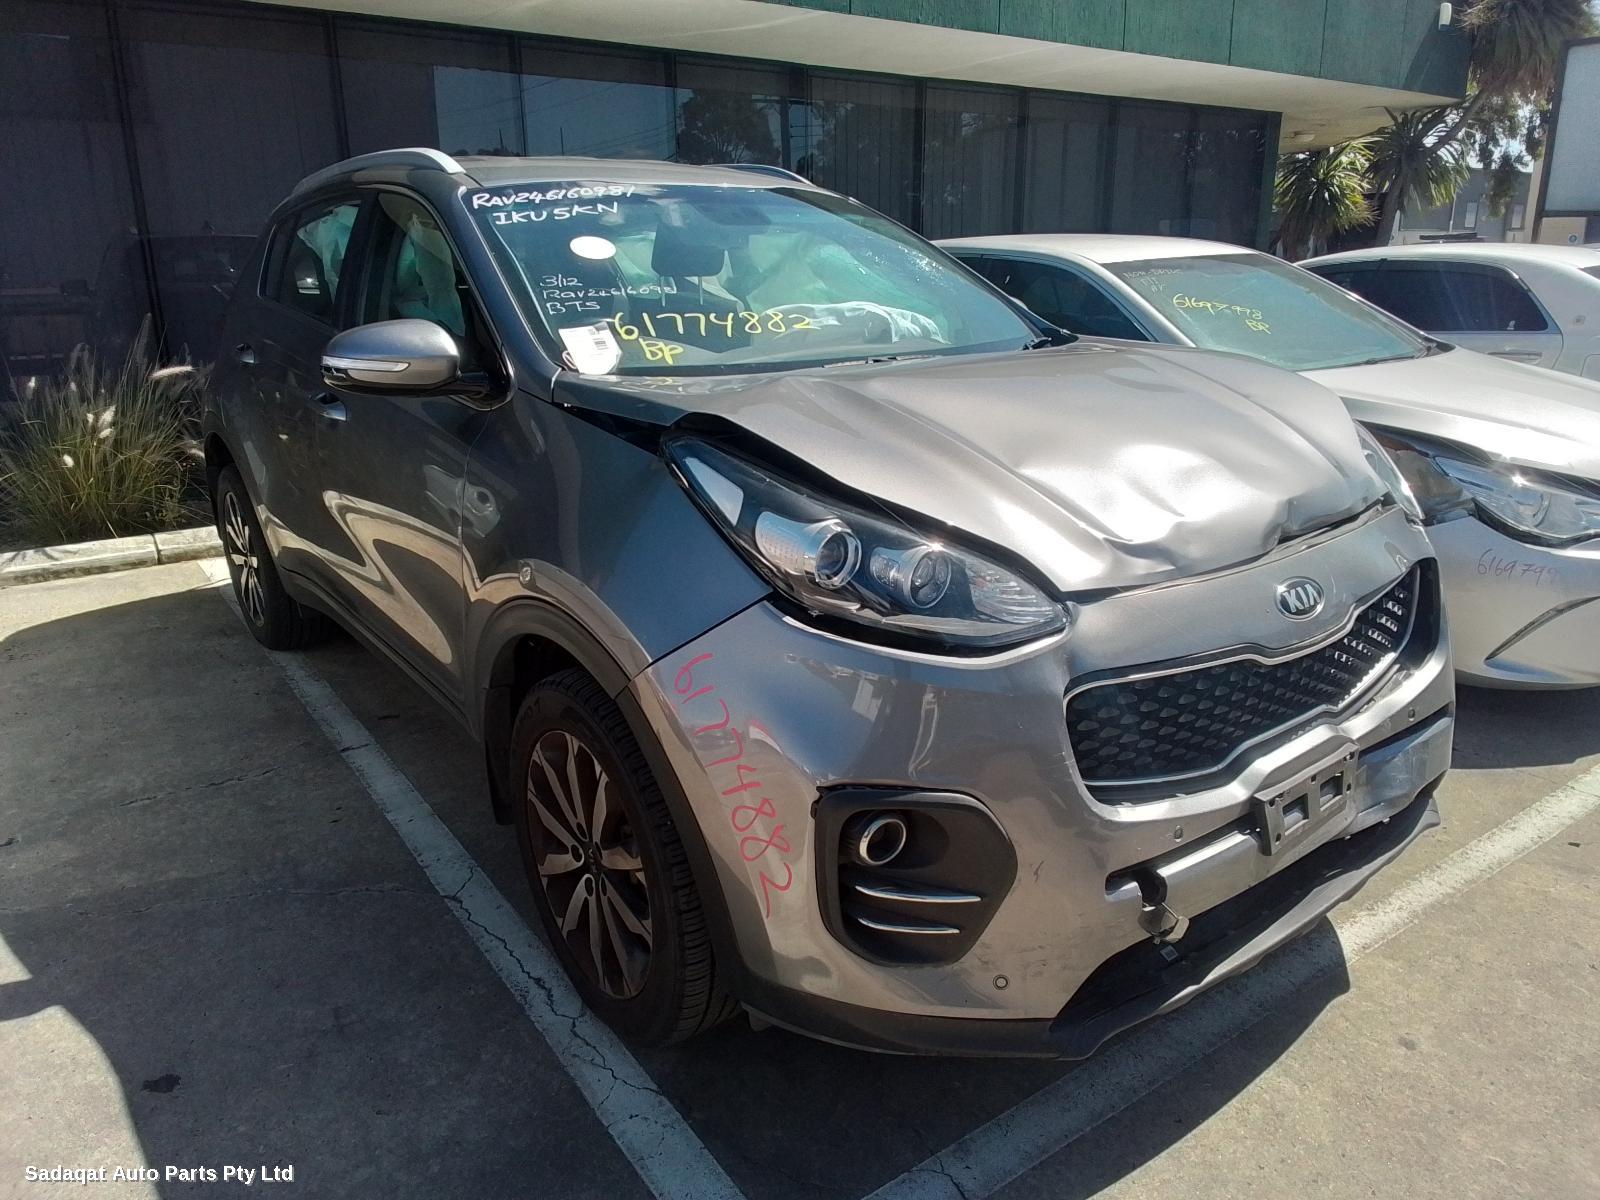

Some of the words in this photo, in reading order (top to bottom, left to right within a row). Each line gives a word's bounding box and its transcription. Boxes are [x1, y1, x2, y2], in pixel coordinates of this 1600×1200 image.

[540, 274, 583, 288] 3/12
[546, 300, 601, 315] BTS
[614, 311, 821, 341] 61774882
[1281, 583, 1321, 613] KIA
[674, 652, 793, 920] 61774882
